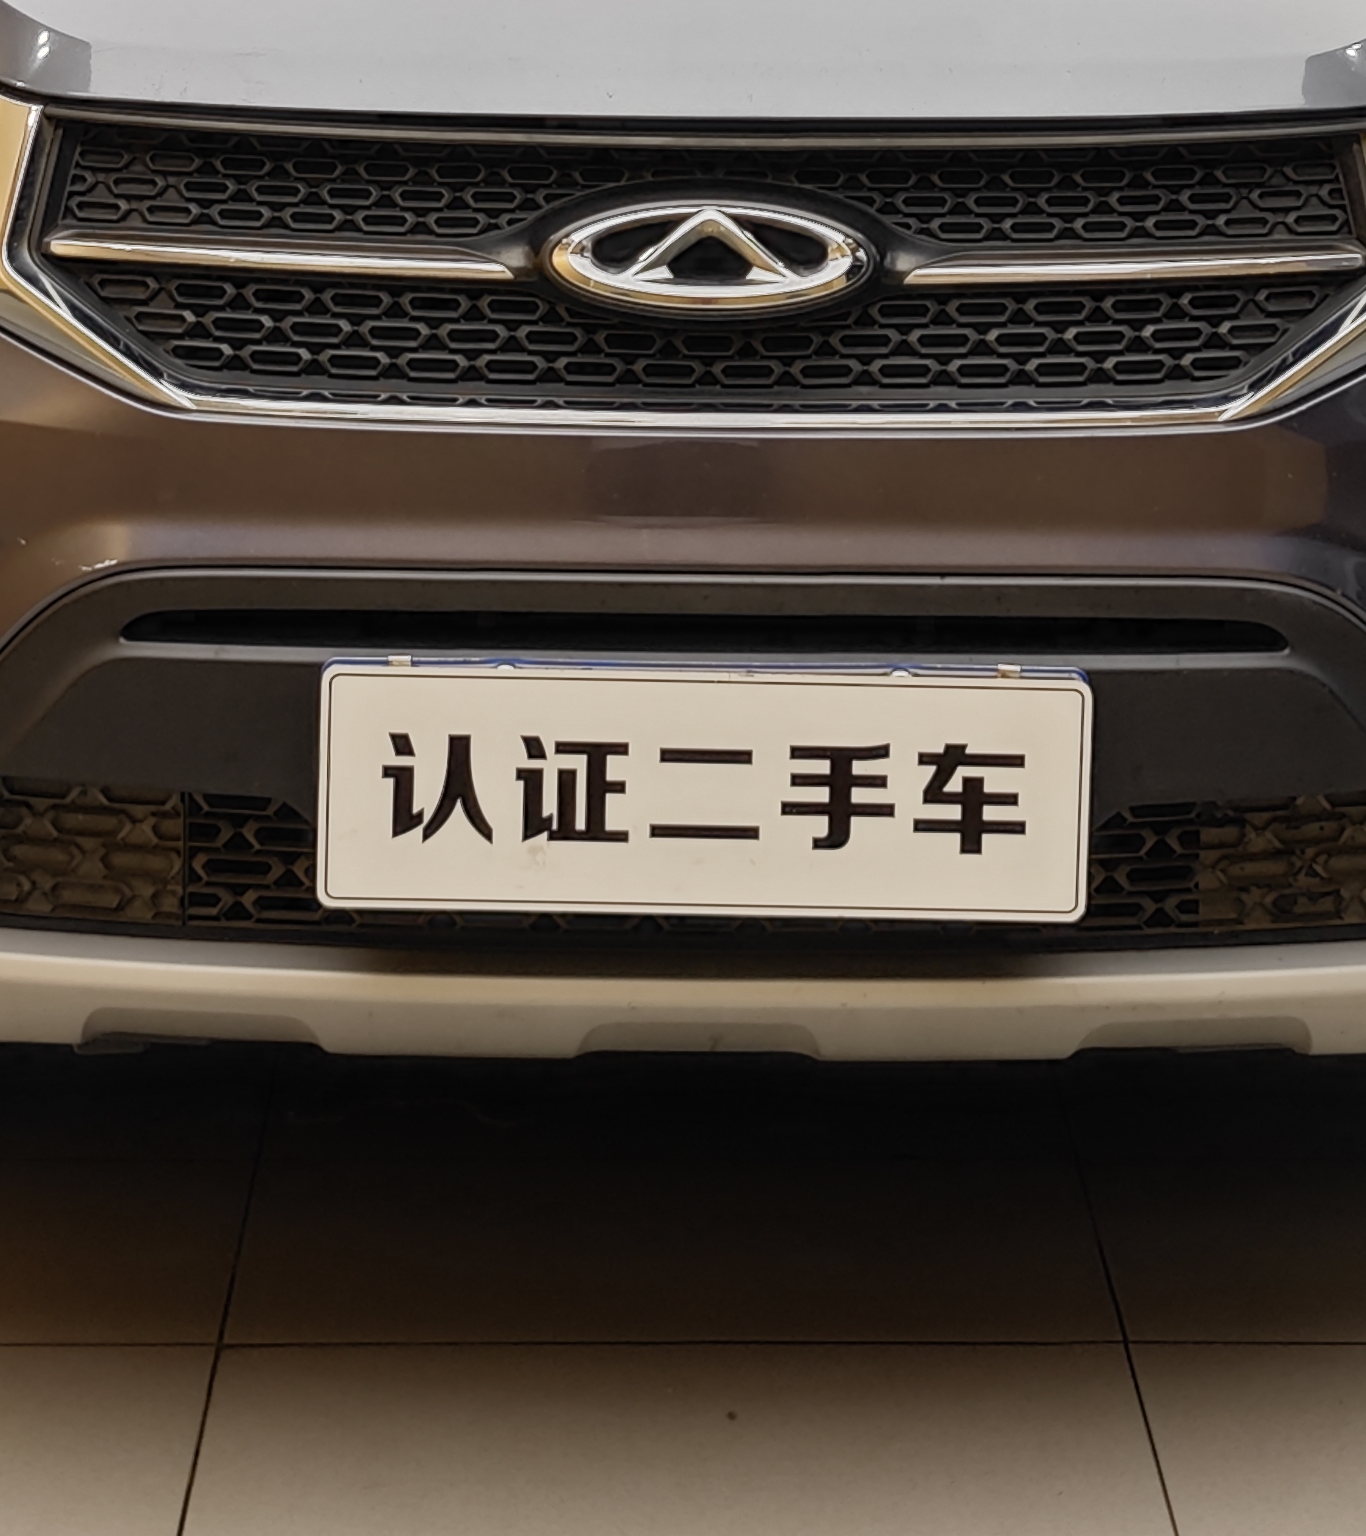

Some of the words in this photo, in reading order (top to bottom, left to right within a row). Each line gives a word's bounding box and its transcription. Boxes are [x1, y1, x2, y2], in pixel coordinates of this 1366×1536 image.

[381, 731, 1027, 856] 认证二手车
